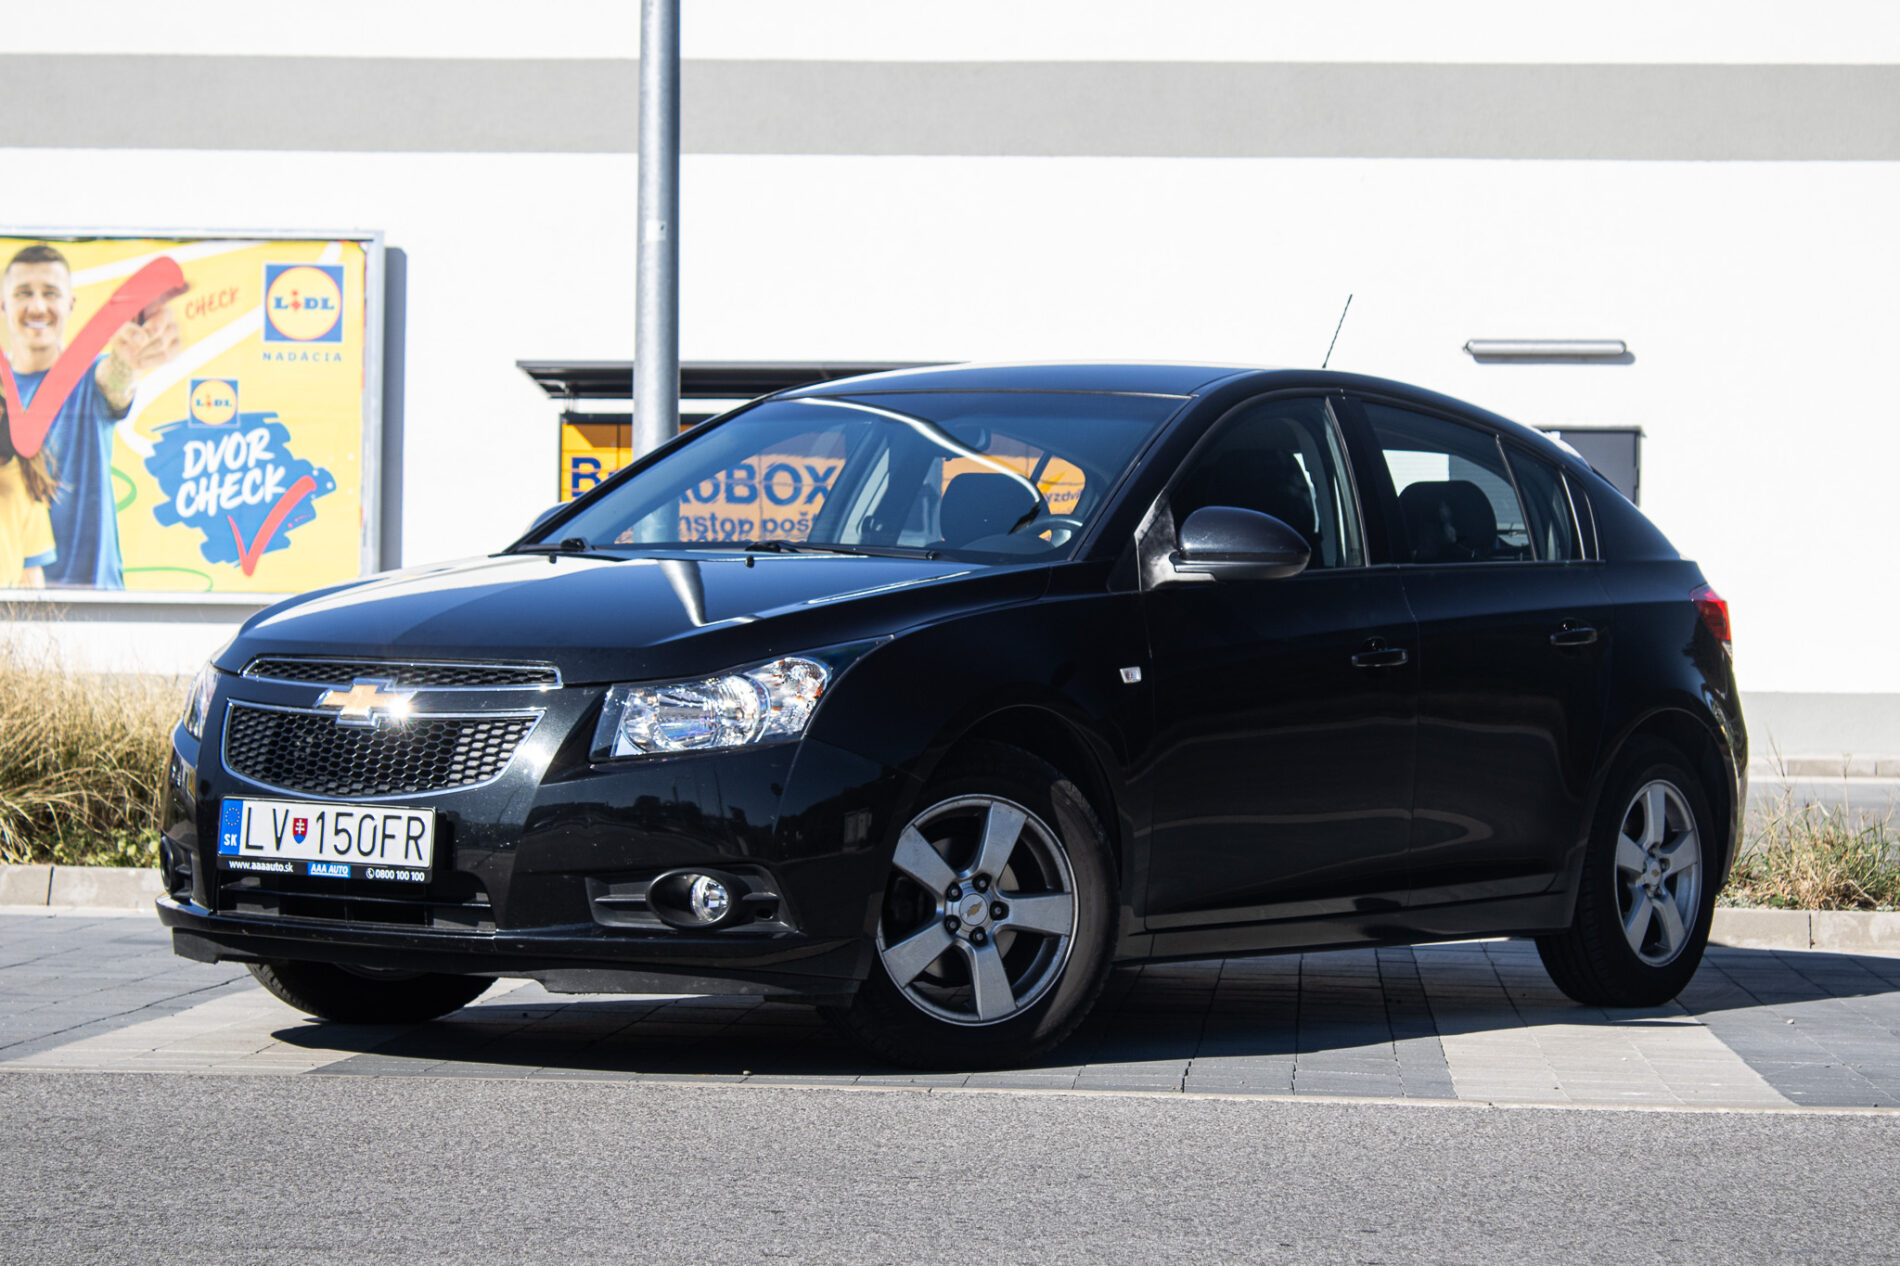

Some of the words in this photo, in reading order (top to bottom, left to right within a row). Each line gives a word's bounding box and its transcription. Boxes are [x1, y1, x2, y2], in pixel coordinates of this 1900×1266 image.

[185, 287, 239, 320] CHECK
[182, 427, 275, 479] DVOR
[176, 463, 286, 518] CHECK
[223, 833, 238, 847] SK
[244, 807, 290, 851] LV
[316, 811, 426, 861] 150FR
[228, 860, 294, 873] www.aaaauto.sk
[310, 863, 328, 874] AAA
[328, 864, 349, 875] AUTO
[375, 868, 395, 880] 0800
[396, 870, 411, 881] 100
[411, 871, 426, 882] 100
